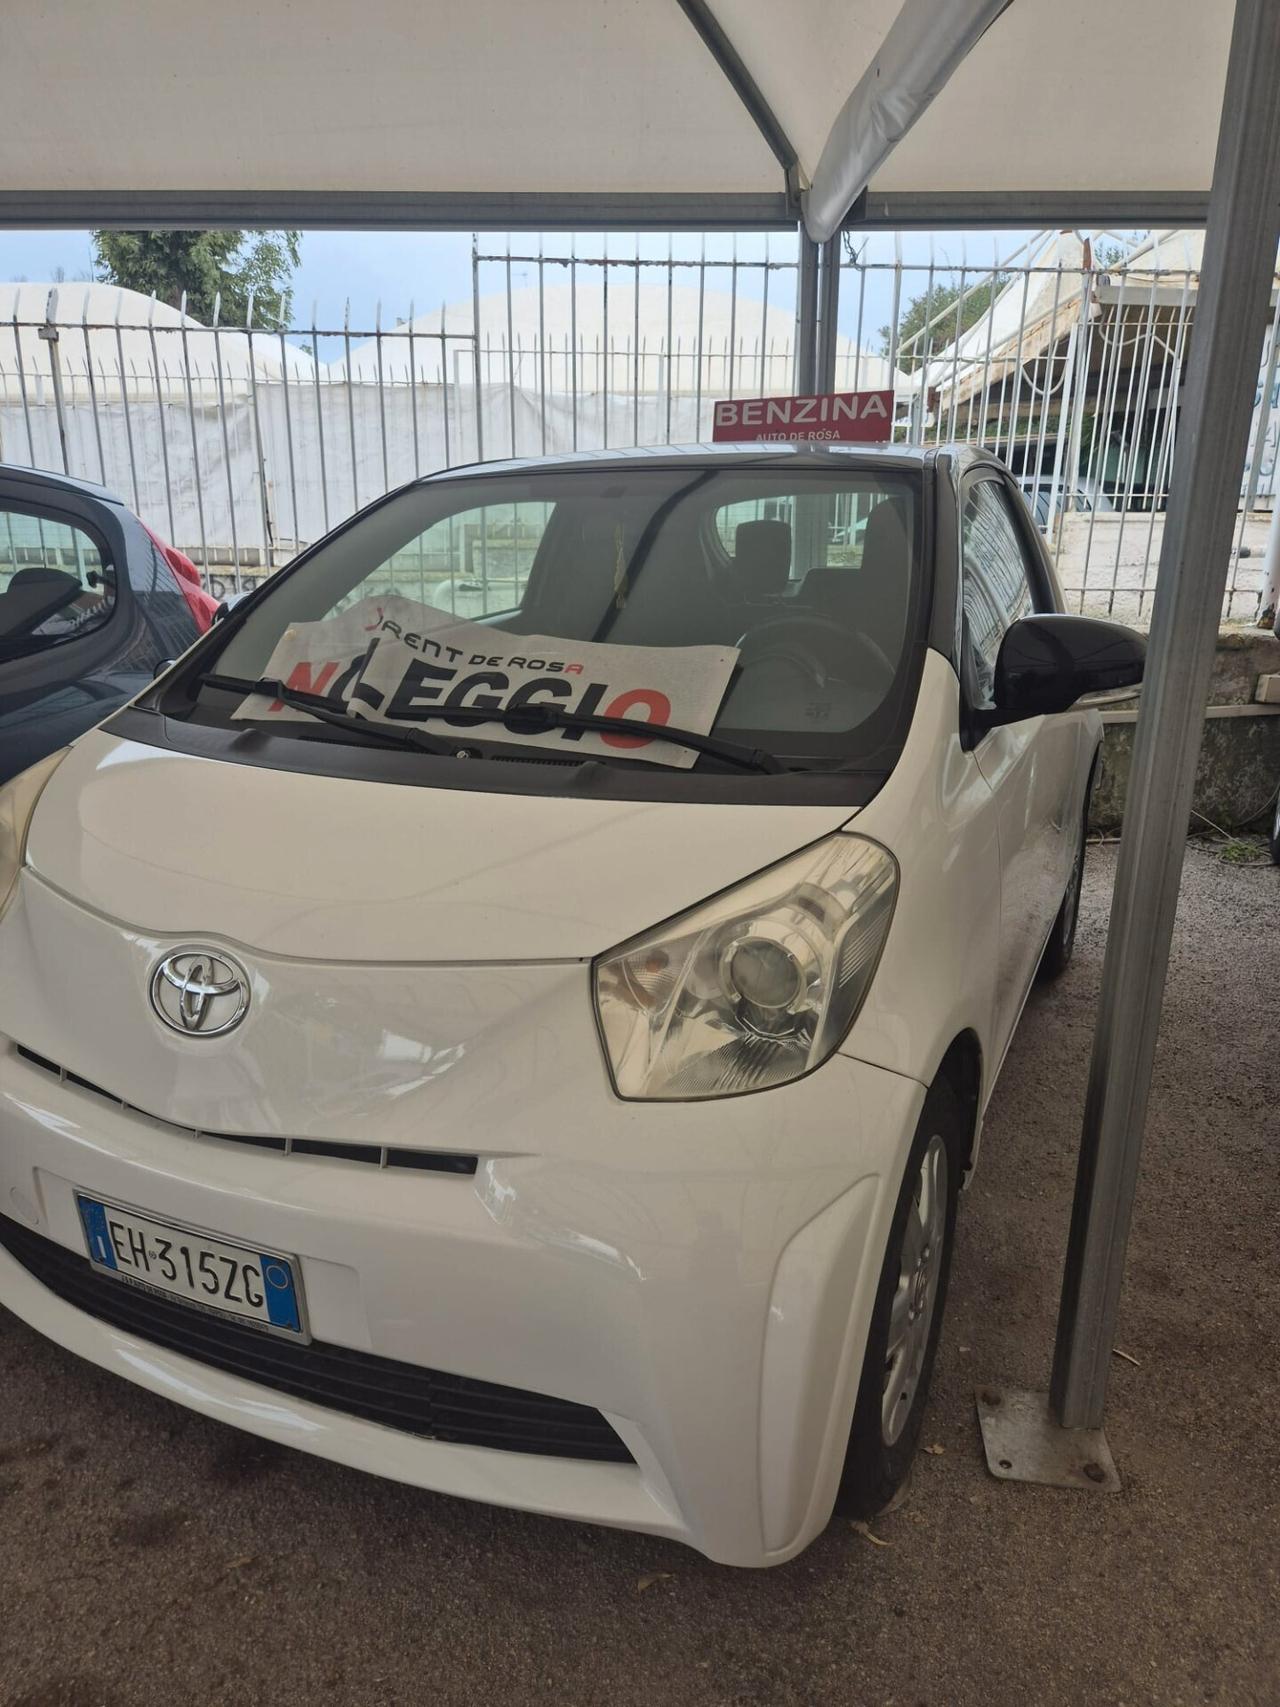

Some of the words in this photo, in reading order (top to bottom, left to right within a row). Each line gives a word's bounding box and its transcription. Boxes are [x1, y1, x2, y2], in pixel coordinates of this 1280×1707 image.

[715, 394, 888, 427] BENZINA
[755, 432, 787, 441] AUTO
[790, 432, 805, 441] DE
[808, 430, 841, 441] ROSA
[381, 619, 464, 664] RENT
[468, 654, 504, 667] DE
[507, 656, 585, 675] ROSA
[109, 1220, 264, 1308] EH315ZG
